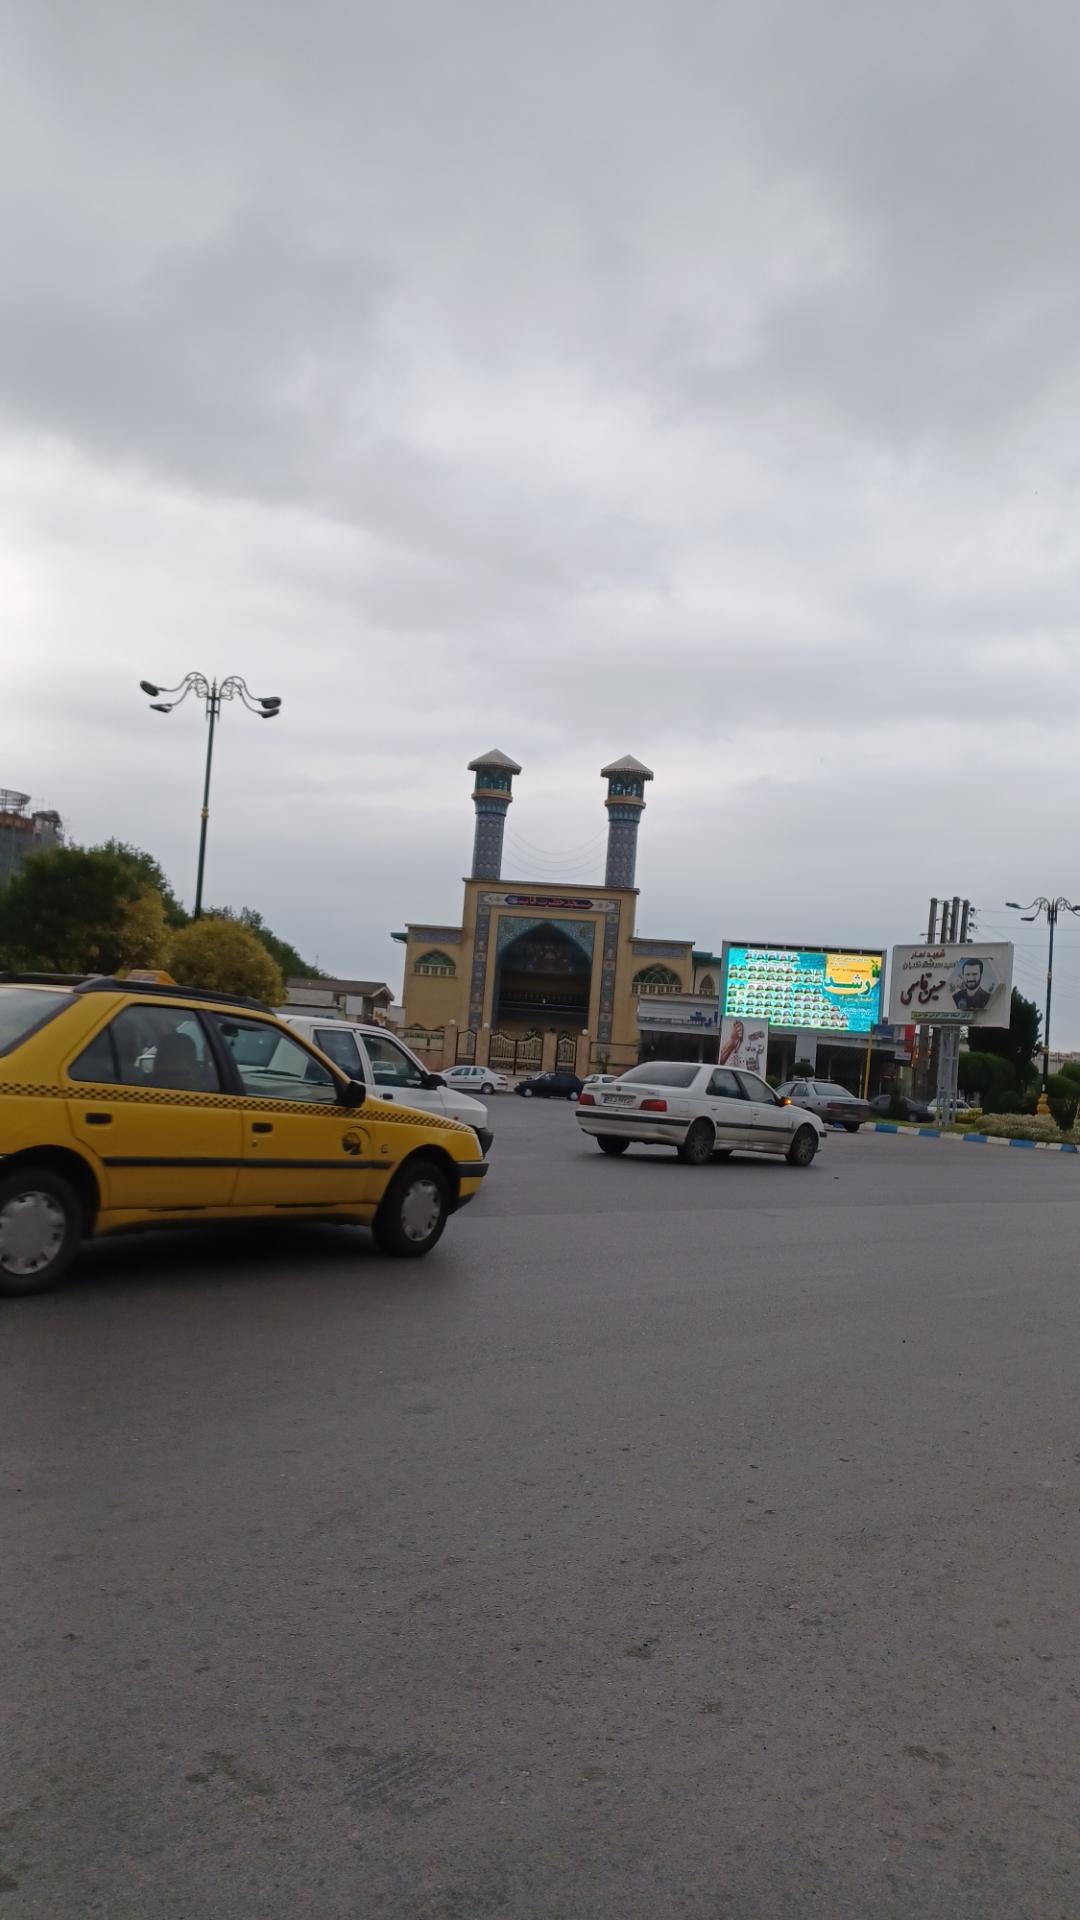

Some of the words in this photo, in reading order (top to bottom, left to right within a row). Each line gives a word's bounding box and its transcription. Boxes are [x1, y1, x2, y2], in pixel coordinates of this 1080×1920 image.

[926, 949, 946, 960] شهید
[823, 974, 872, 996] رشد
[900, 972, 932, 1006] قاسمی
[918, 980, 947, 1004] حسین
